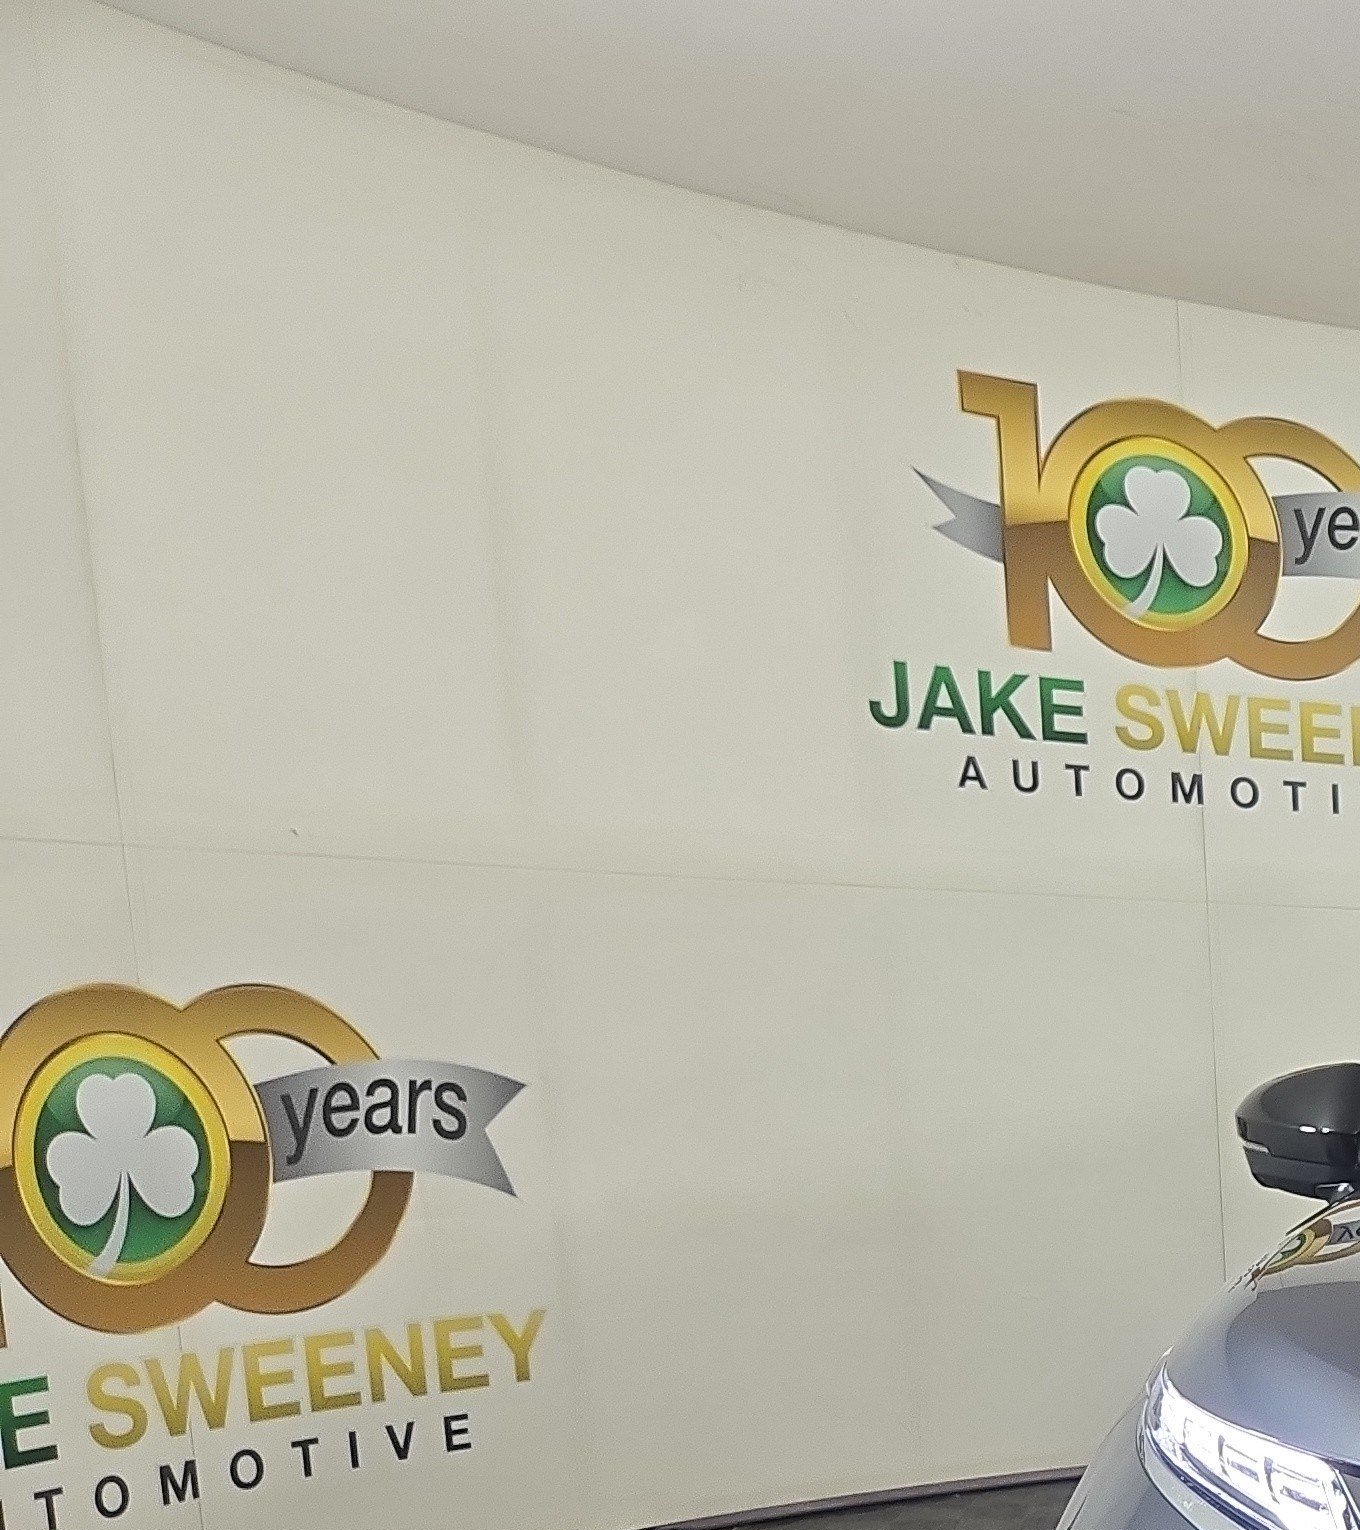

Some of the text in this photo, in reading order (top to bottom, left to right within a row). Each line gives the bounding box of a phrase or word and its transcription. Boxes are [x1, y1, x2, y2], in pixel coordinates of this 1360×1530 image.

[868, 660, 1088, 746] JAKE
[0, 982, 468, 1347] 00 years
[86, 1308, 547, 1450] SWEENEY
